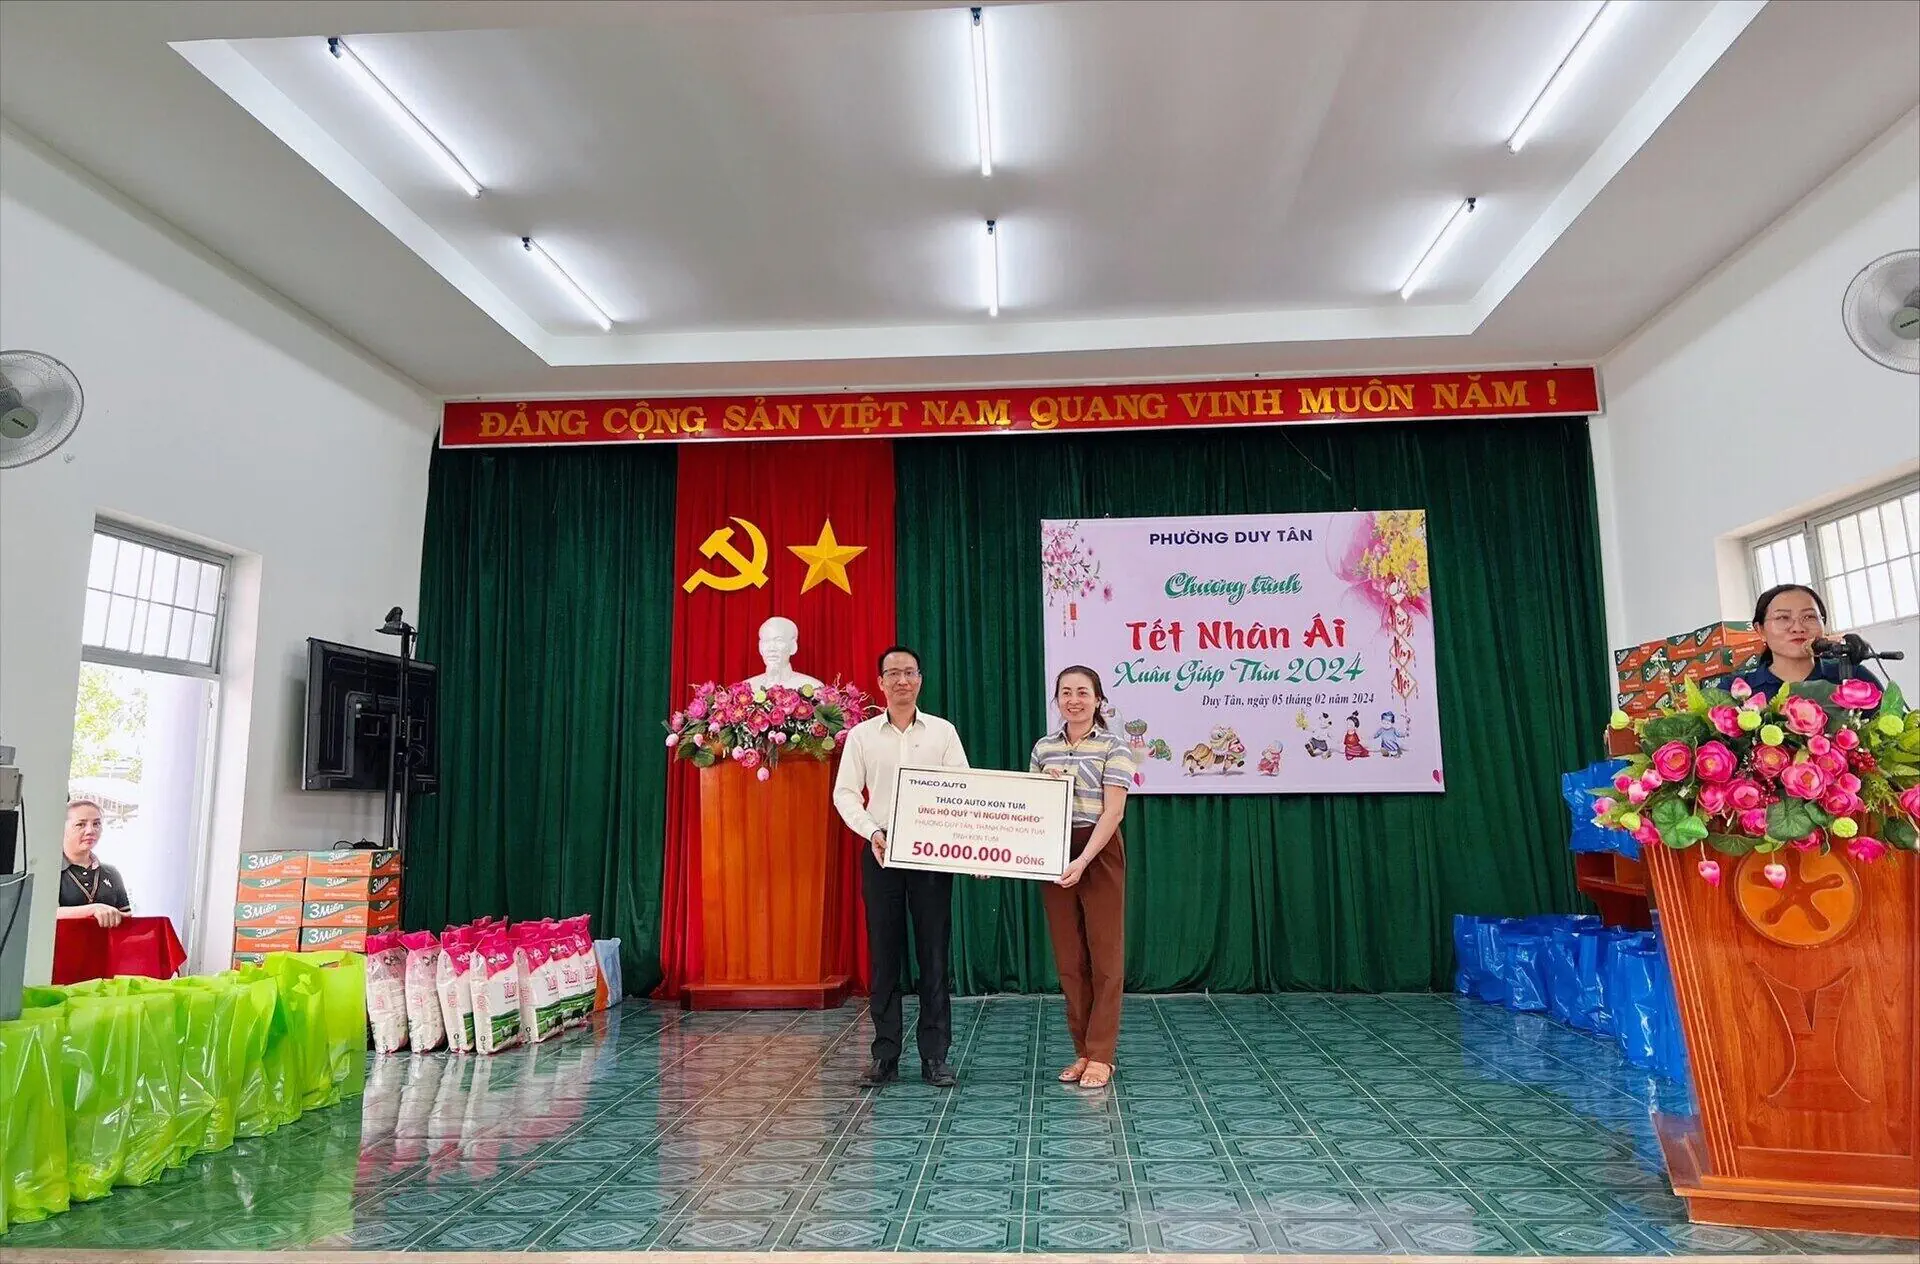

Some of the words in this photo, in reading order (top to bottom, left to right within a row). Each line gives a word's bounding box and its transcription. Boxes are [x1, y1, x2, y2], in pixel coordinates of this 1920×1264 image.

[478, 402, 589, 437] ĐẢNG
[602, 400, 707, 440] CỘNG
[722, 396, 802, 431] SẢN
[813, 395, 909, 434] VIỆT
[920, 399, 1012, 427] NAM
[1029, 392, 1168, 430] QUANG
[1177, 388, 1284, 418] VINH
[1298, 378, 1415, 414] MUÔN
[1431, 373, 1530, 409] NĂM
[1546, 379, 1557, 406] !
[1149, 529, 1229, 545] PHƯỜNG
[1234, 530, 1271, 544] DUY
[1277, 526, 1313, 542] TÂN
[1164, 571, 1247, 606] Chương
[1249, 572, 1303, 595] trình
[1125, 618, 1185, 653] Tết
[1196, 620, 1291, 650] Nhân
[1303, 612, 1346, 648] Ái
[1112, 657, 1171, 688] Xuân
[1174, 659, 1225, 692] Giáp
[1229, 658, 1281, 683] Thìn
[1284, 651, 1365, 683] 2024
[1224, 694, 1245, 707] Tân,
[1247, 694, 1270, 708] ngày
[1271, 693, 1284, 705] 05
[1285, 693, 1312, 707] tháng
[1314, 693, 1326, 705] 02
[1328, 693, 1349, 704] năm
[1351, 692, 1375, 704] 2024
[908, 778, 940, 787] THACO
[941, 781, 967, 789] AUTO
[935, 796, 963, 805] THACO
[963, 798, 986, 807] AUTO
[987, 800, 1005, 809] KON
[1007, 801, 1026, 810] TUM
[911, 840, 1012, 864] 50.000.000
